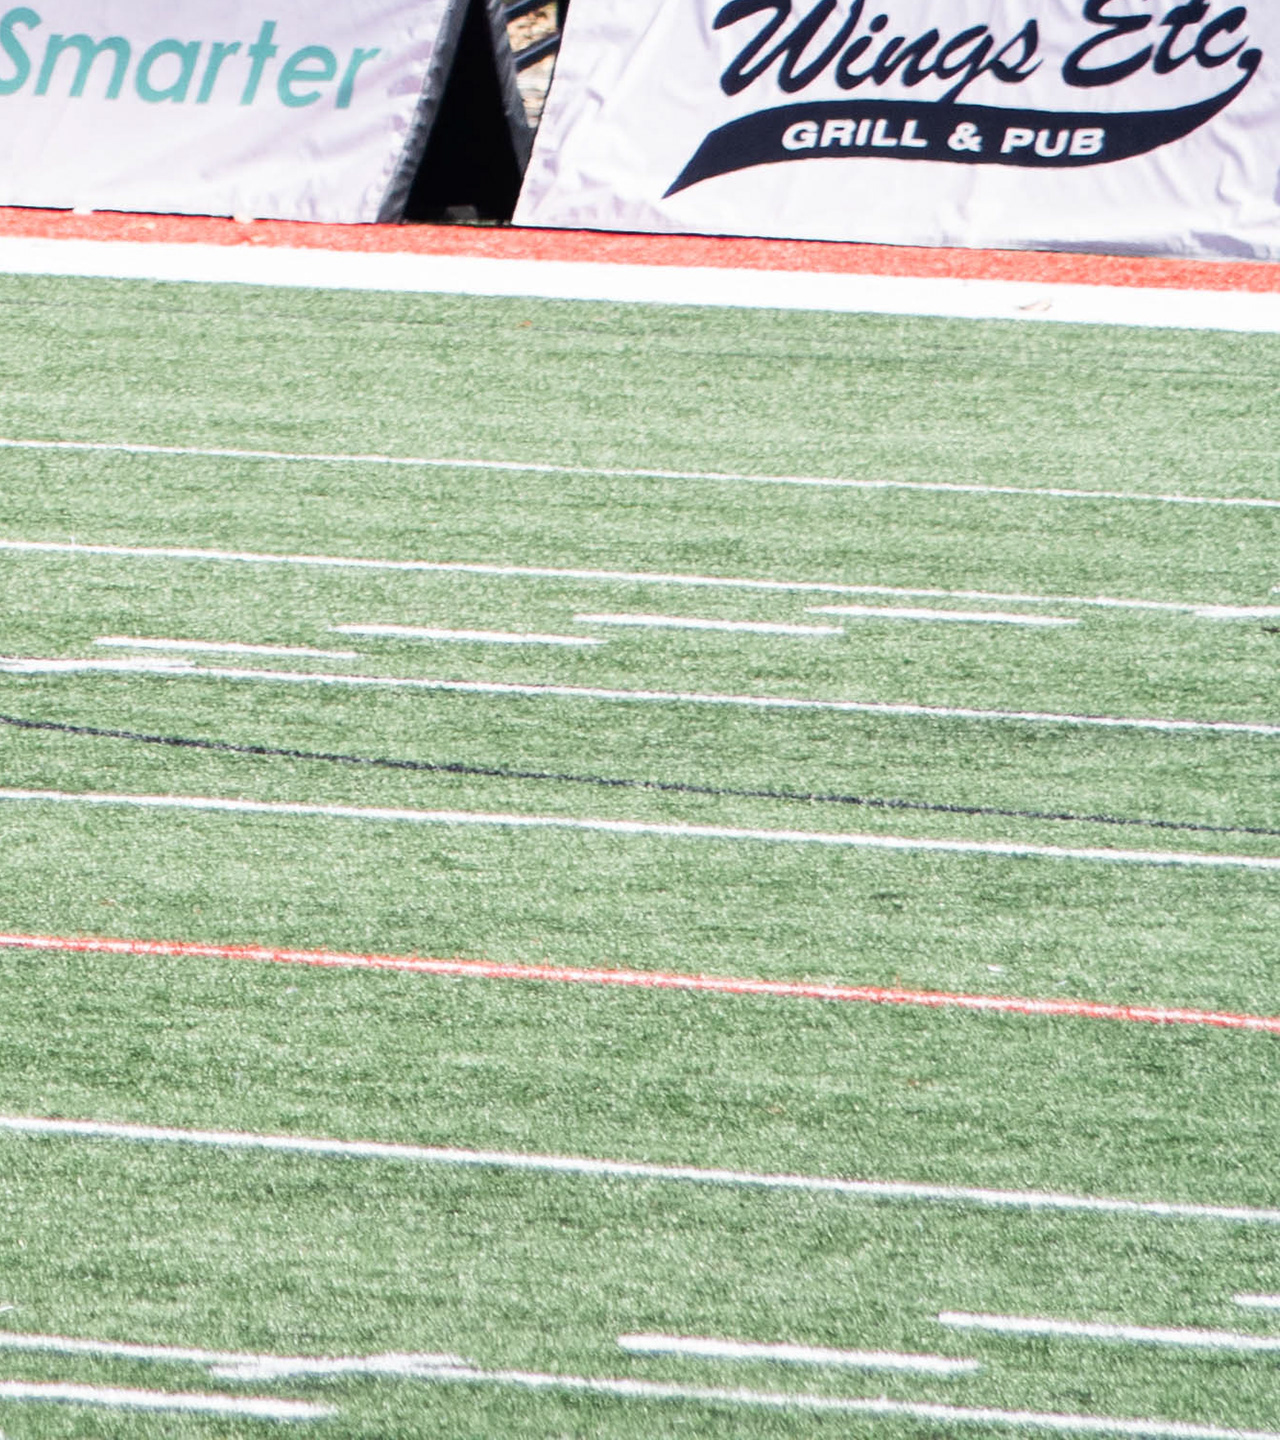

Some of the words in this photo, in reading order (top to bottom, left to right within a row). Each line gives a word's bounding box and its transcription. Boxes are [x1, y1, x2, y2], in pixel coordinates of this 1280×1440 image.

[781, 119, 929, 151] GRILL
[946, 121, 983, 153] &
[1000, 127, 1106, 158] PUB
